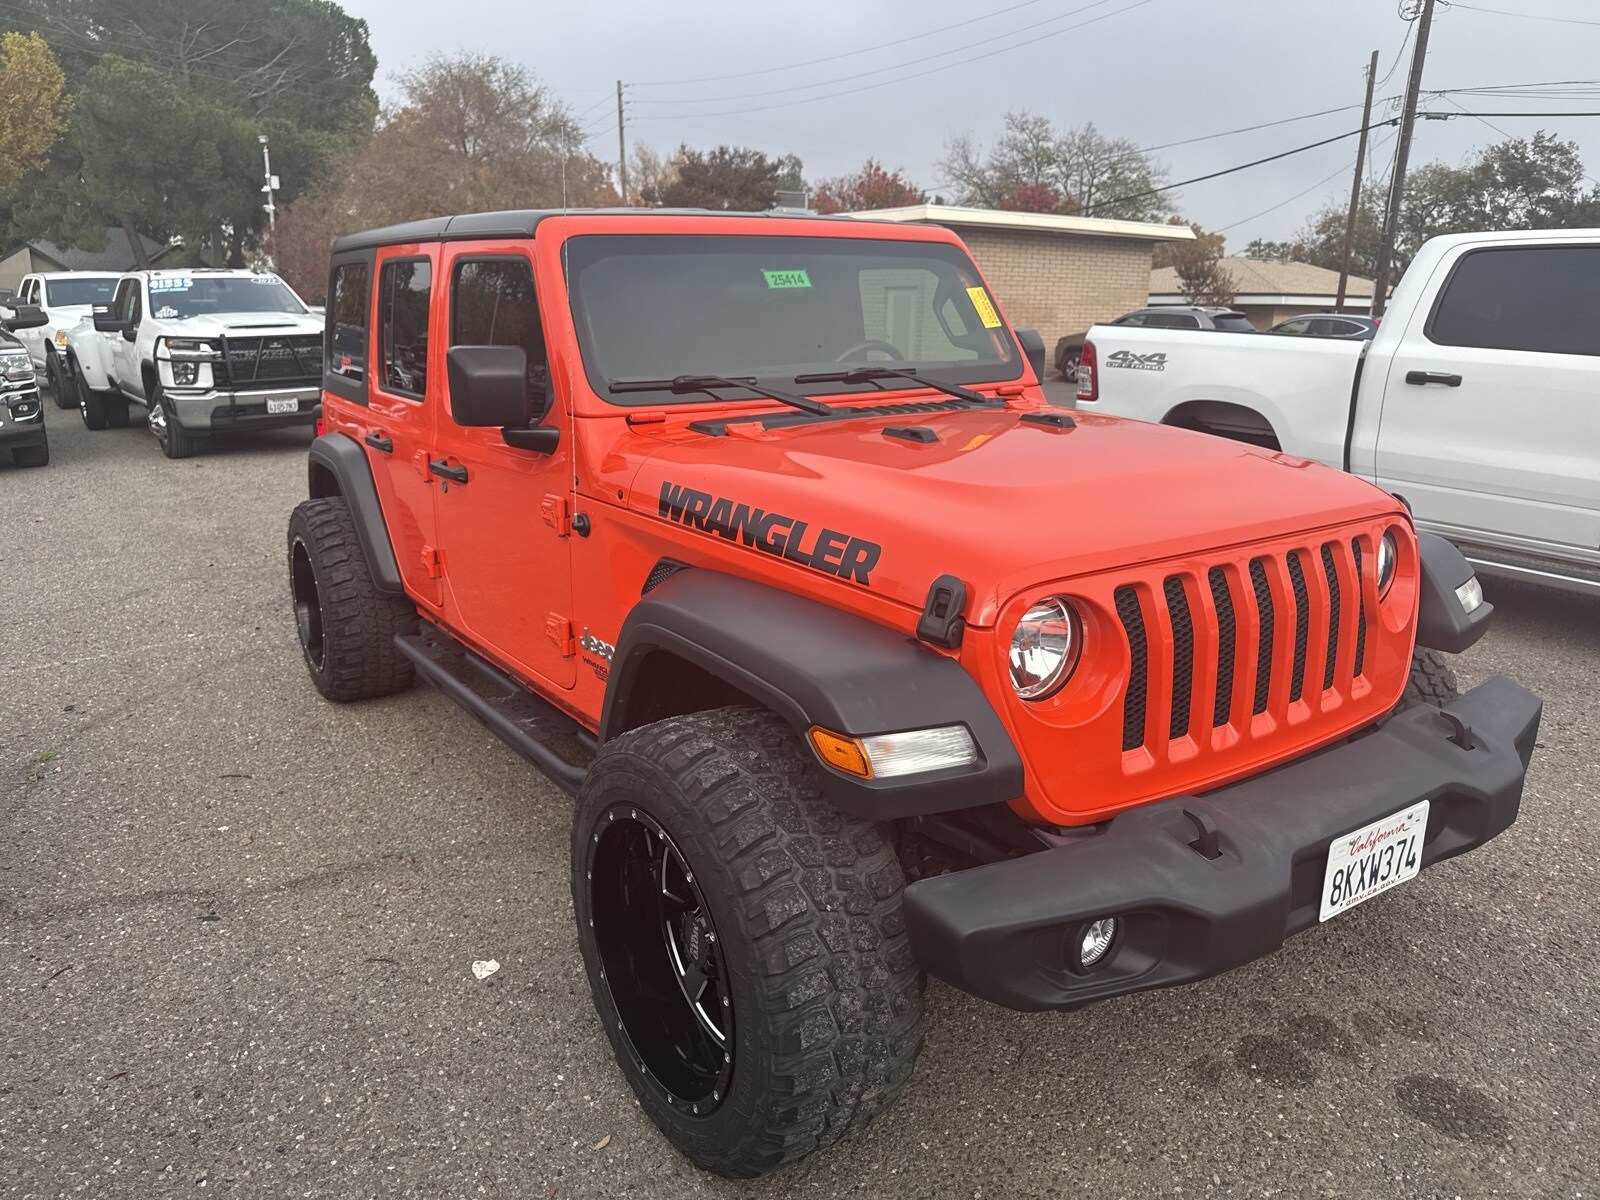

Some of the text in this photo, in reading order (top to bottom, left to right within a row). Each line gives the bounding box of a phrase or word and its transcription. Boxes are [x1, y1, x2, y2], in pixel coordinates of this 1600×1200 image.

[771, 274, 804, 286] 25414
[1107, 350, 1168, 366] 4x4
[658, 480, 882, 587] WRANGLER
[579, 626, 615, 664] Jeep
[1349, 822, 1410, 857] California
[1330, 834, 1417, 906] 8KXW374
[1346, 879, 1396, 906] dmv.ca.gov
